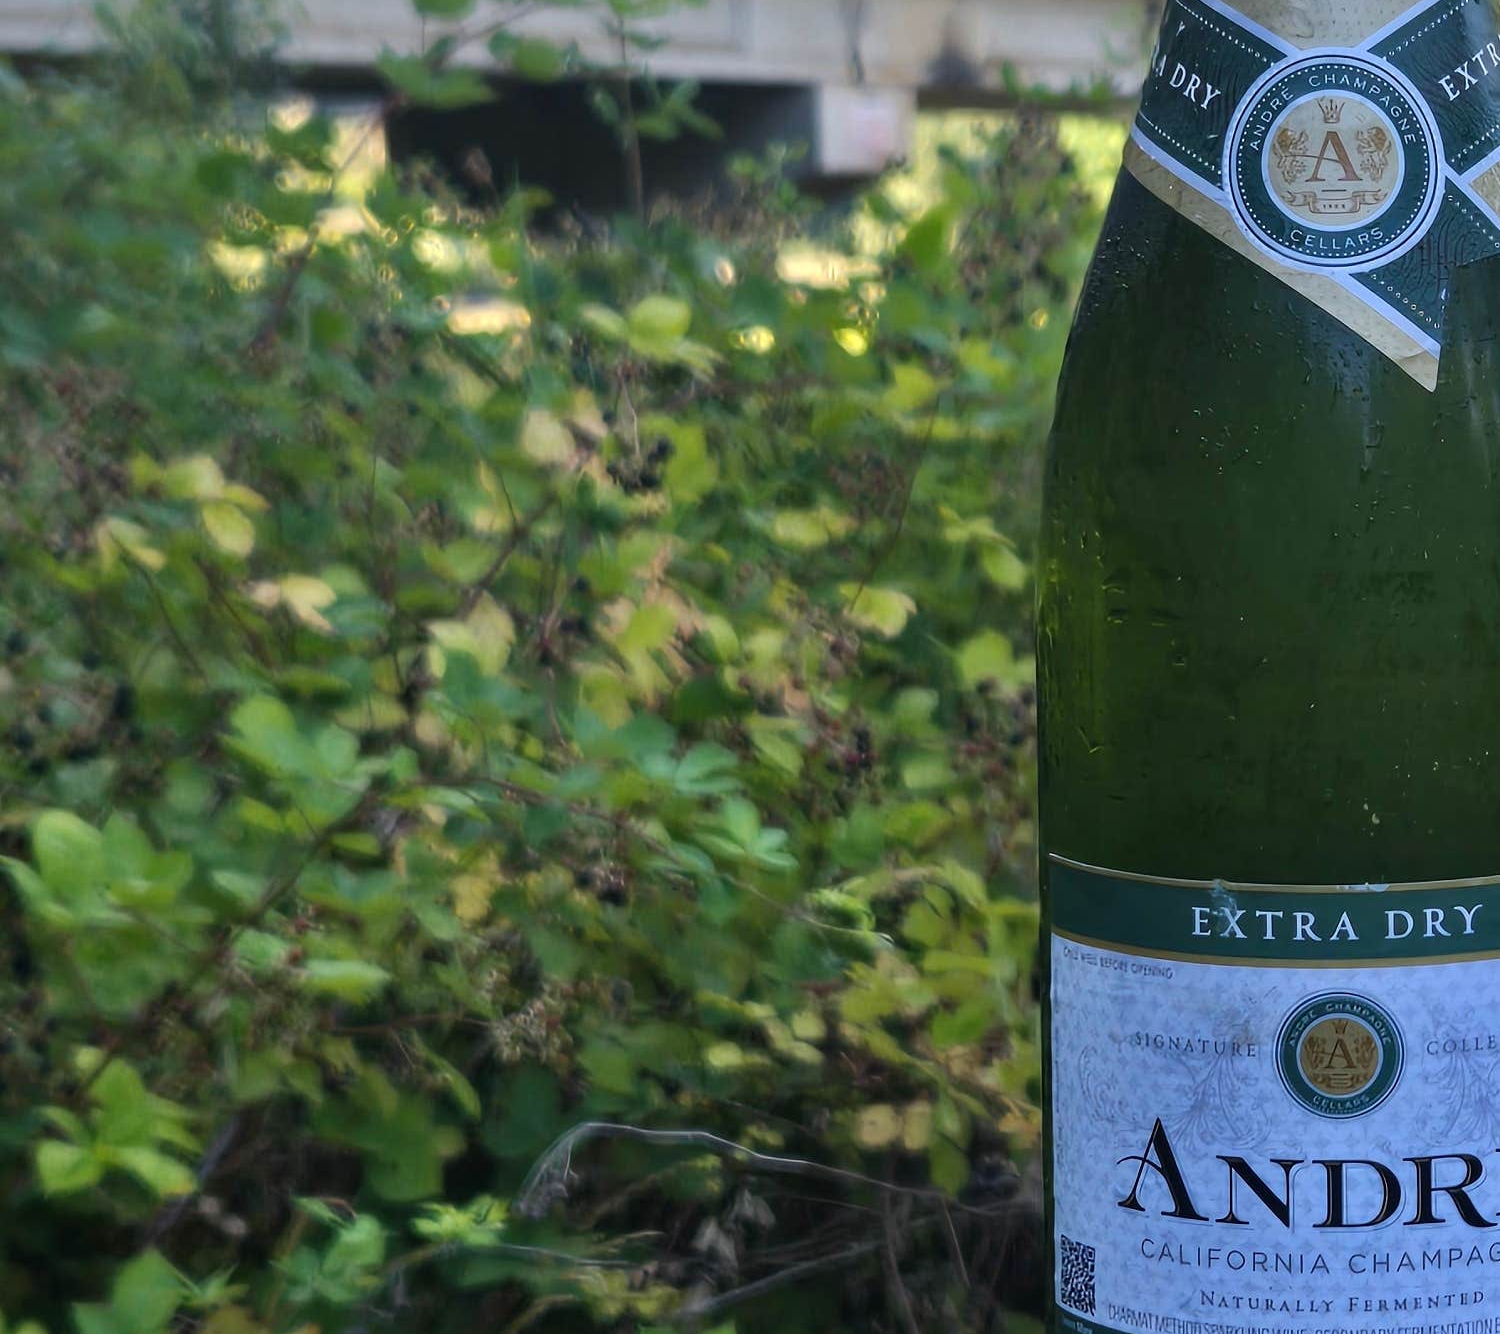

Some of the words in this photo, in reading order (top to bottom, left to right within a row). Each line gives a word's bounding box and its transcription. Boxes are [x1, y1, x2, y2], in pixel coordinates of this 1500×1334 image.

[1169, 62, 1221, 110] DRY
[1308, 74, 1417, 146] CHAMPAGNE
[1290, 226, 1383, 250] CELLARS
[1191, 906, 1359, 943] EXTRA
[1385, 904, 1483, 939] DRY
[1134, 1031, 1257, 1057] SIGNATURE
[1141, 1238, 1330, 1275] CALIFORNIA
